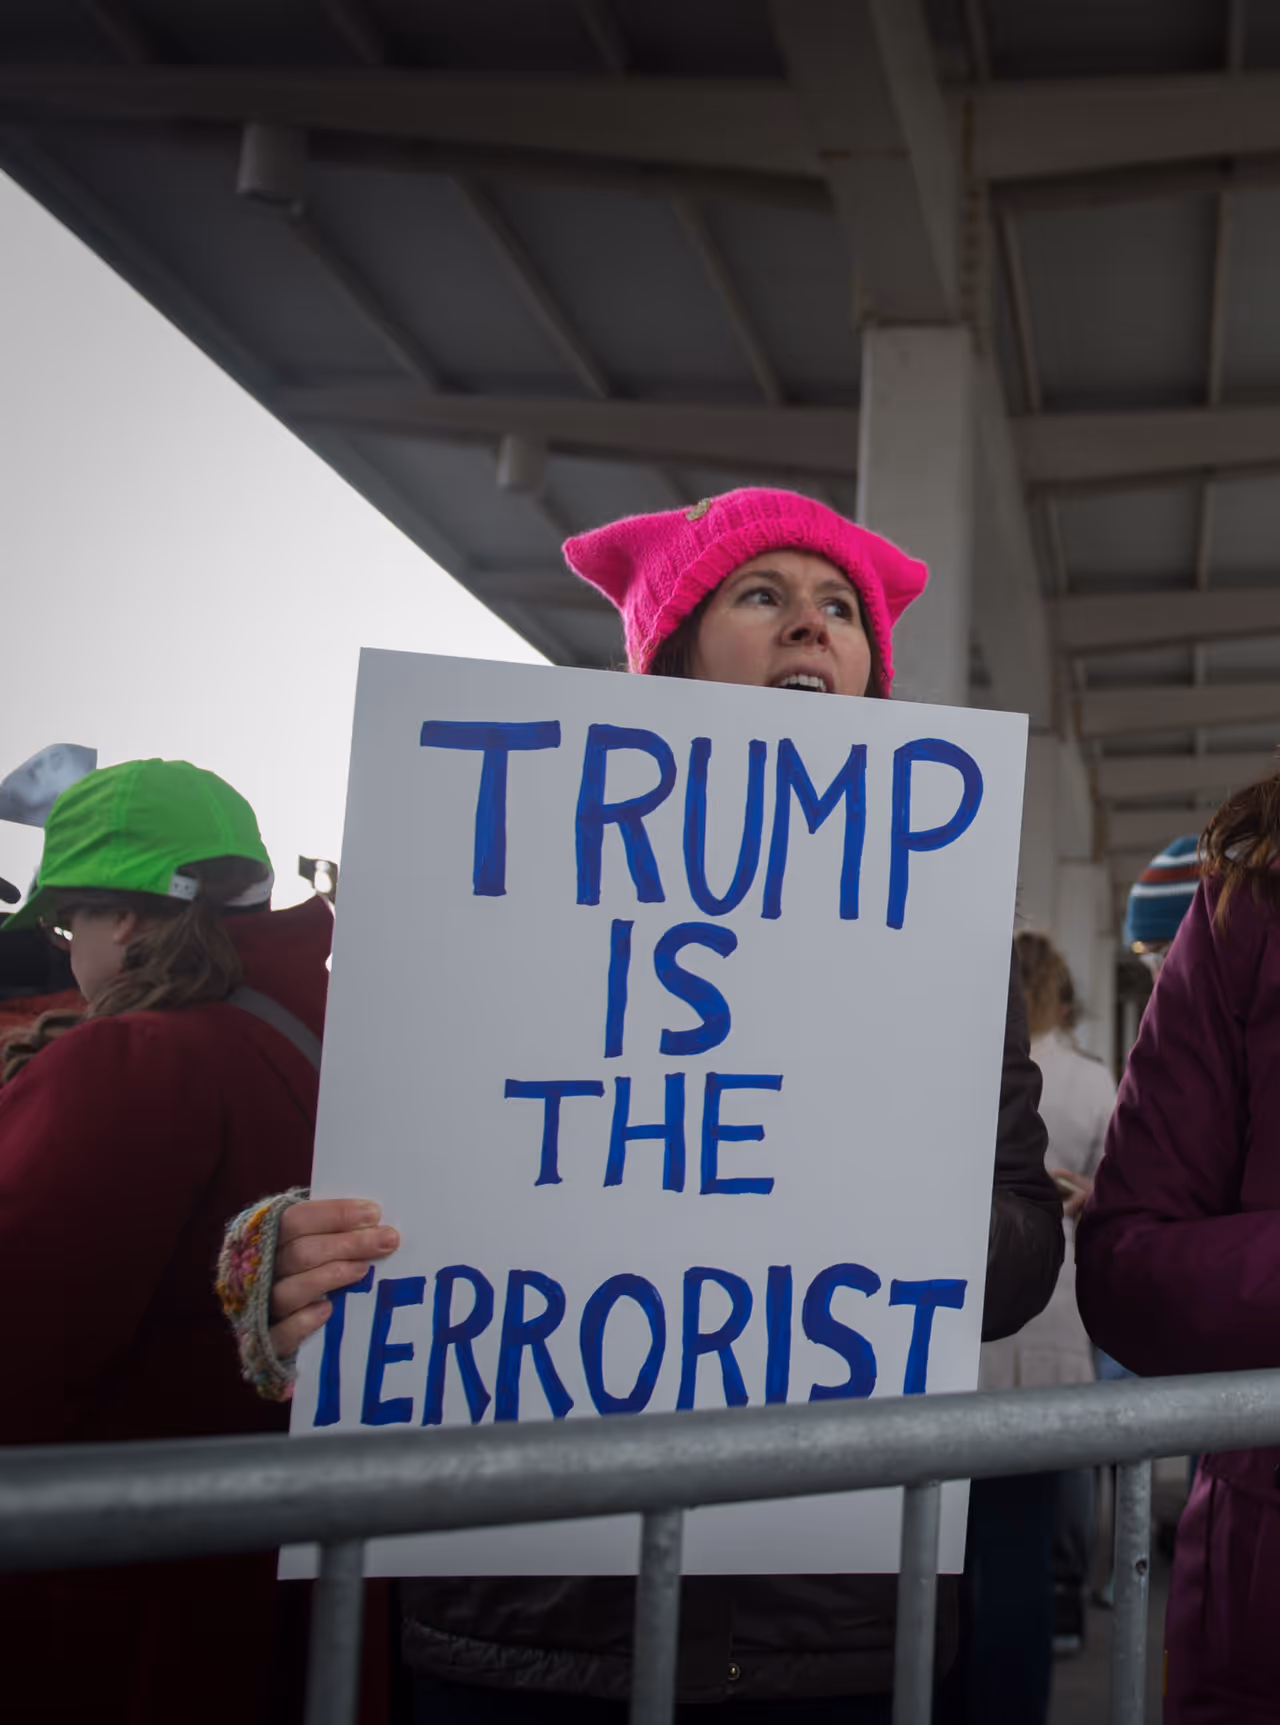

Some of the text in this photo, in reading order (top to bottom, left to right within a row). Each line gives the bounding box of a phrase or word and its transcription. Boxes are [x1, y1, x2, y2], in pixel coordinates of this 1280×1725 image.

[420, 720, 985, 930] TRUMP
[604, 918, 738, 1058] IS
[503, 1072, 784, 1196] THE
[314, 1262, 969, 1426] TERRORIST
